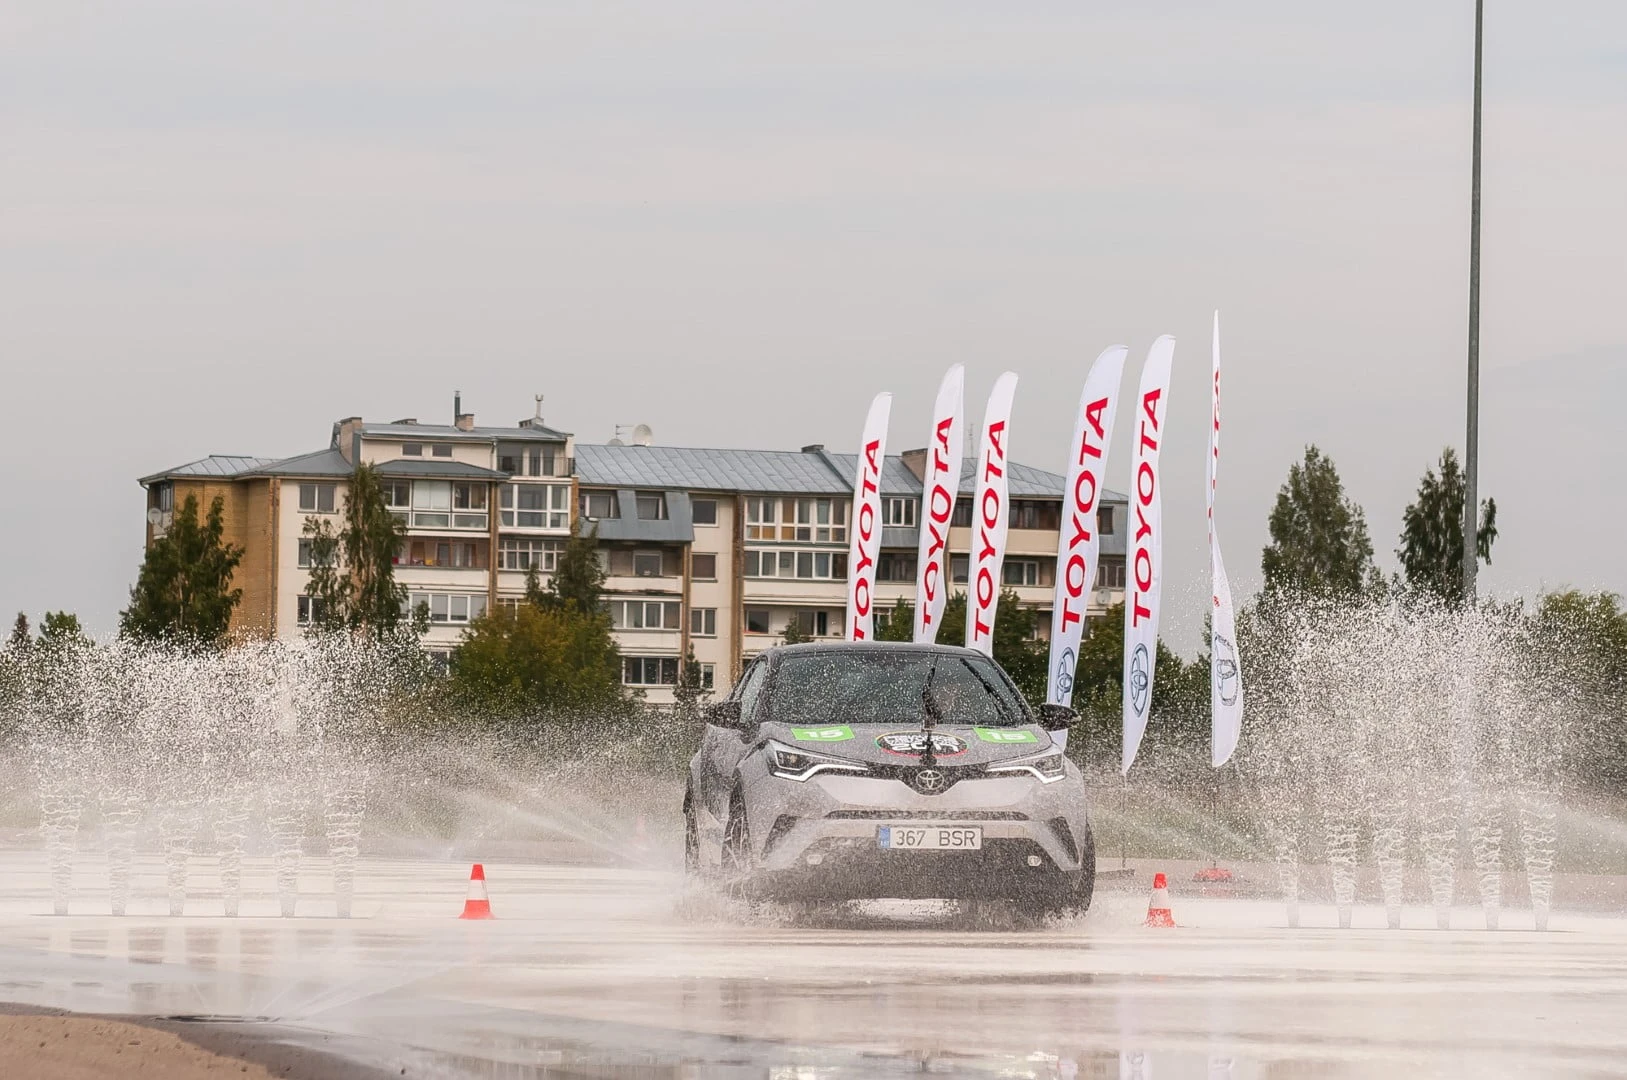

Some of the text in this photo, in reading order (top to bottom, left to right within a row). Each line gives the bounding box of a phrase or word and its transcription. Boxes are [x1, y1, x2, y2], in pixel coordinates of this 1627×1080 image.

[853, 439, 880, 641] TOYOTA
[922, 417, 954, 634] TOYOTA
[974, 420, 1006, 641] TOYOTA
[1061, 397, 1109, 633] TOYOTA
[1132, 388, 1162, 628] TOYOTA
[803, 730, 844, 738] 15
[896, 830, 975, 847] 367 BSR
[986, 731, 1026, 740] 15
